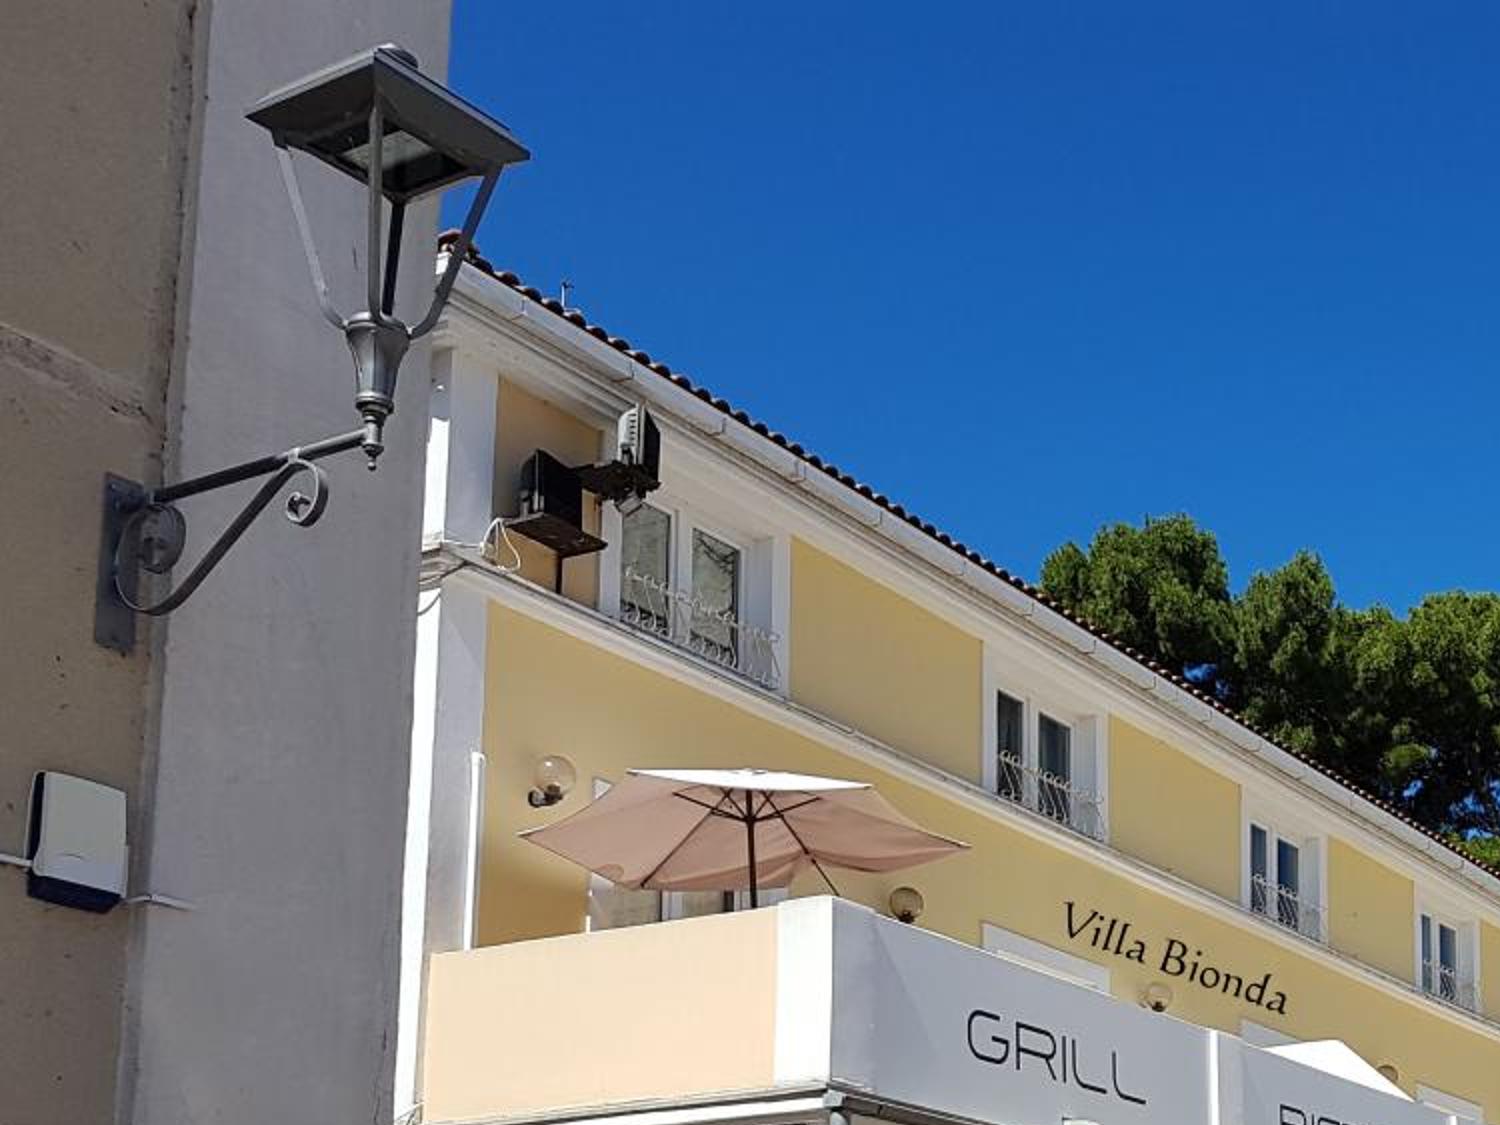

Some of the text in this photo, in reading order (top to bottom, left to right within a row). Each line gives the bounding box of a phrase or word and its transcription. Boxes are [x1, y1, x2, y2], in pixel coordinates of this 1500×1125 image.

[1063, 901, 1288, 1015] Villa Bionda
[967, 1009, 1147, 1105] GRILL
